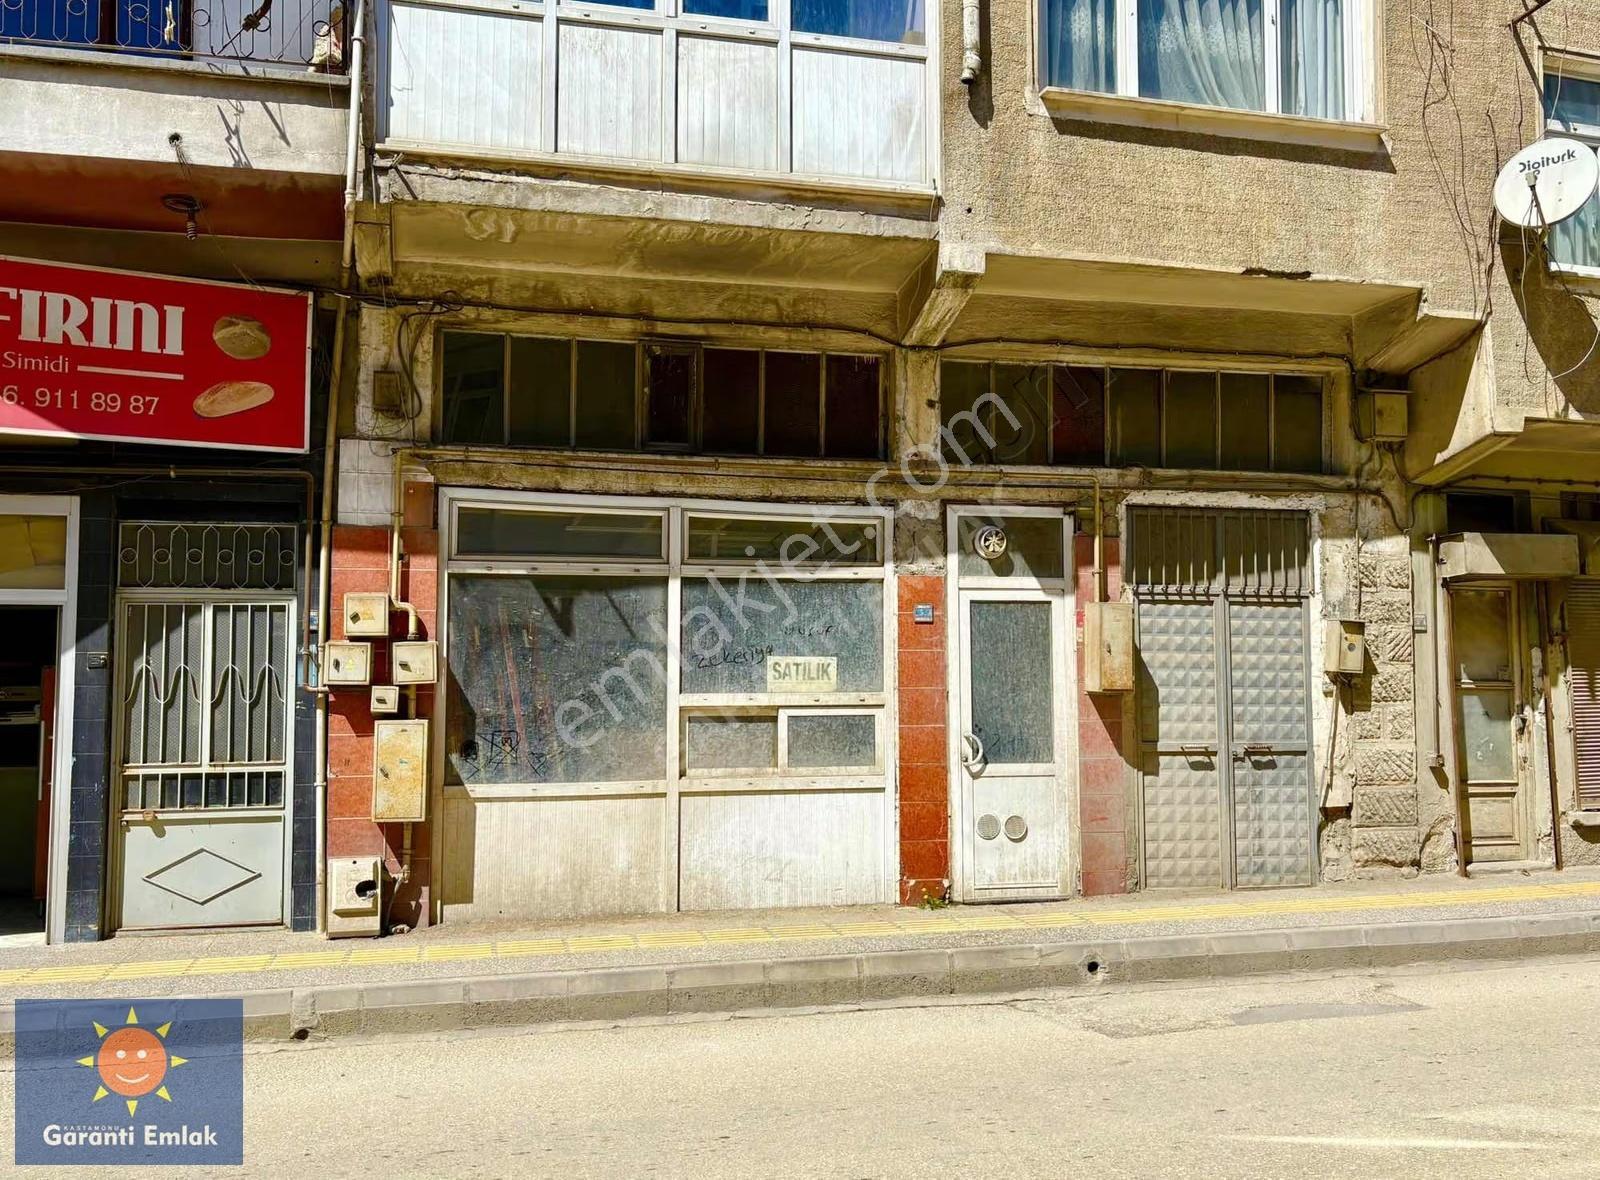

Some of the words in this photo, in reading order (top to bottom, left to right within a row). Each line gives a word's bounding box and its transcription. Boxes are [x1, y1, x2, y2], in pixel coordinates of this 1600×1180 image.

[2, 351, 69, 373] Simidi
[35, 387, 80, 410] 911
[90, 392, 121, 413] 89
[130, 395, 160, 415] 87
[772, 661, 832, 681] SATILIK
